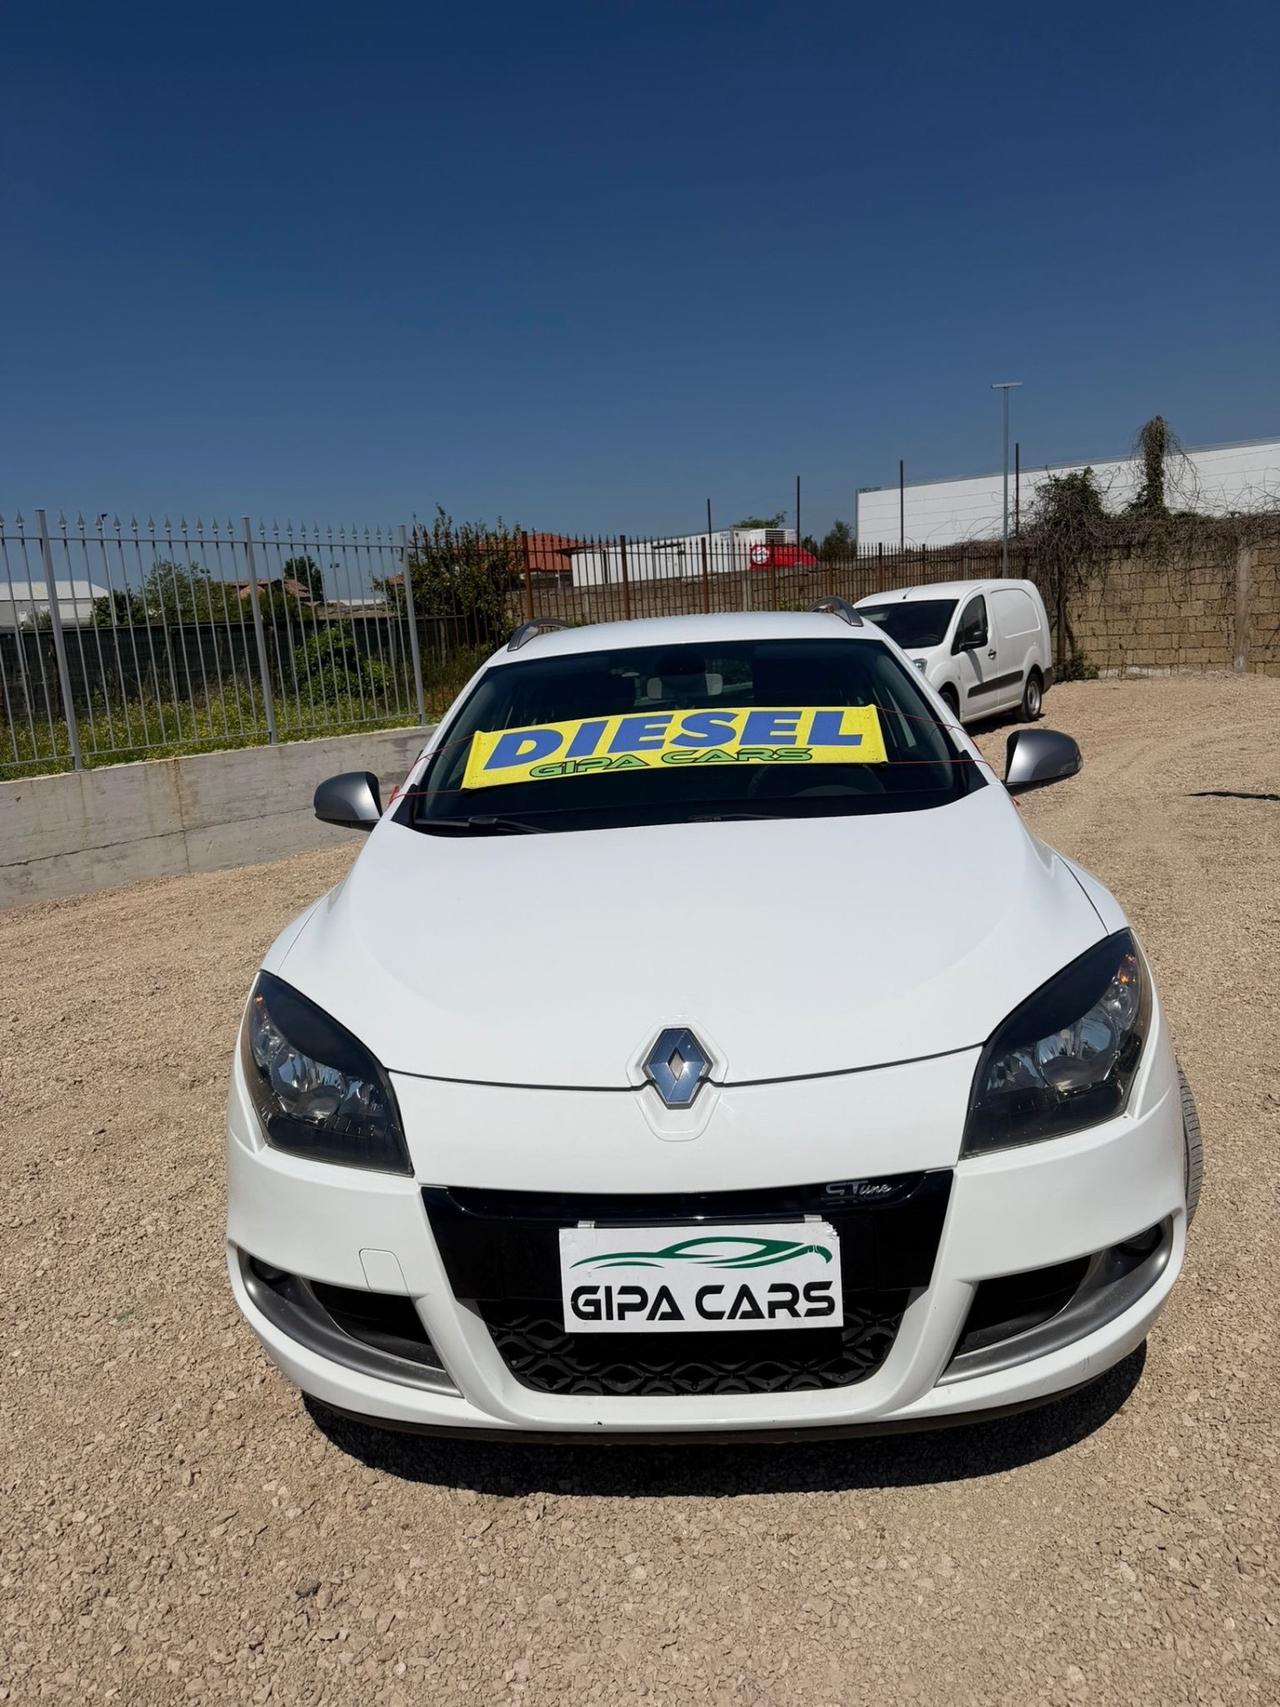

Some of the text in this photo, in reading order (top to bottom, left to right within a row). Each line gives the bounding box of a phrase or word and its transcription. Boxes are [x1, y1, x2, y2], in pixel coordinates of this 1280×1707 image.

[483, 710, 864, 770] DIESEL
[529, 747, 813, 778] GIPA CARS
[570, 1280, 836, 1321] GIPA CARS
